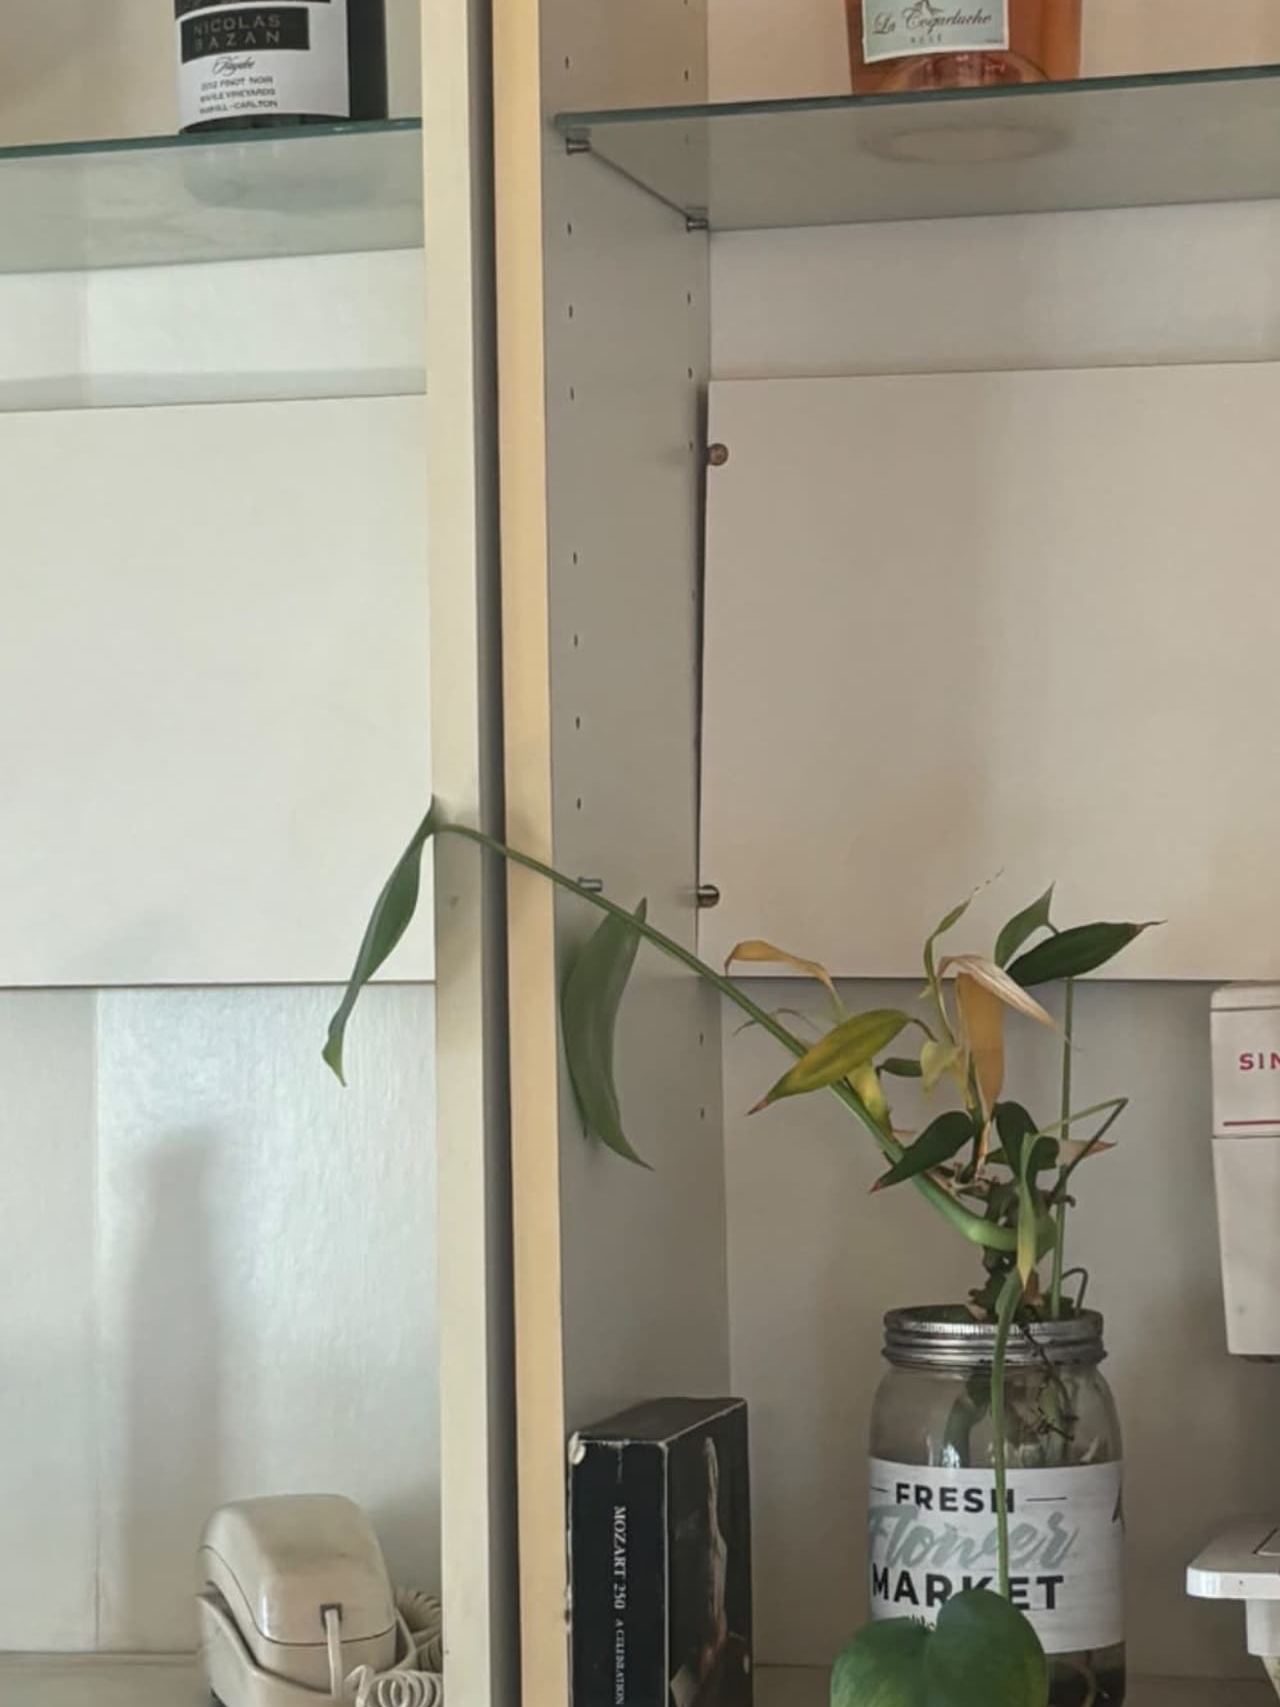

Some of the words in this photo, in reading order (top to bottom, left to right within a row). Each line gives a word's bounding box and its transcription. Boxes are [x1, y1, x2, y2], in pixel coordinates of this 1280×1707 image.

[193, 14, 281, 36] NICOLAS
[872, 12, 897, 35] La
[249, 76, 274, 85] NOIR
[895, 1482, 1015, 1514] FRESH
[613, 1505, 627, 1578] MOZART
[868, 1504, 1080, 1570] Flower
[613, 1582, 627, 1610] 250
[615, 1617, 625, 1628] A
